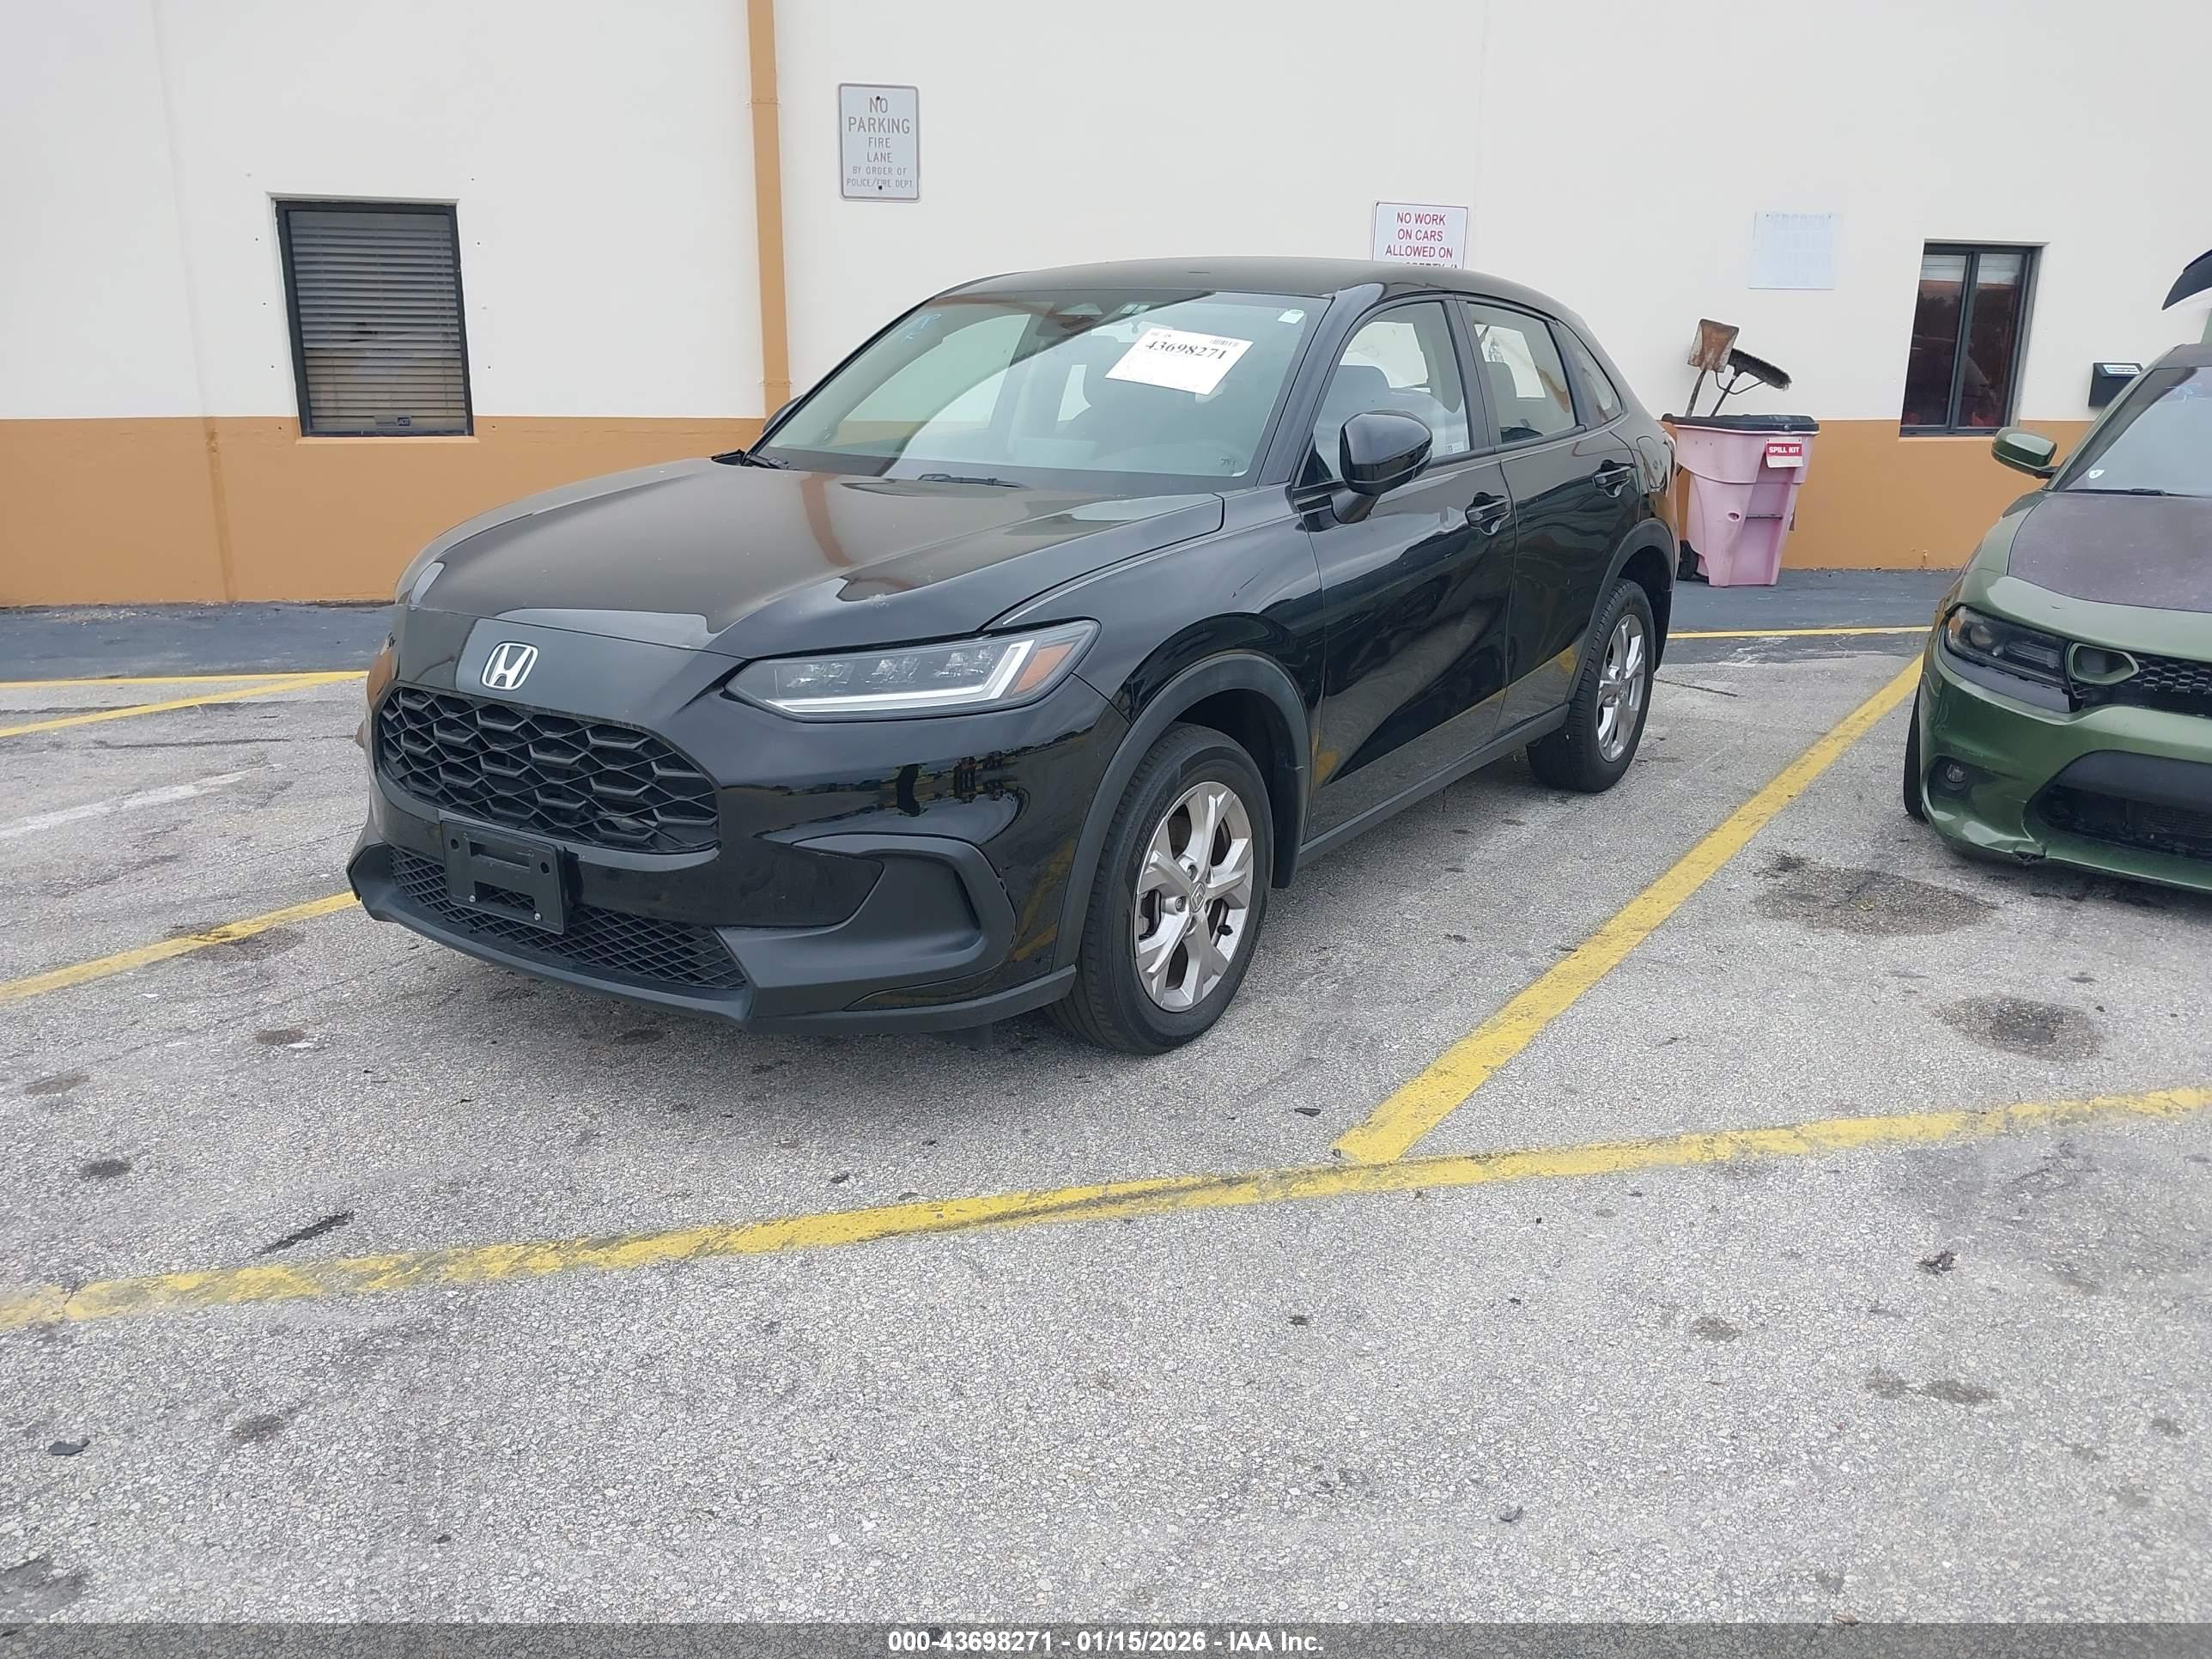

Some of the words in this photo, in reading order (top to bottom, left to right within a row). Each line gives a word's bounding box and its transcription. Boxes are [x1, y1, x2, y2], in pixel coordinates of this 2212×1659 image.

[869, 97, 888, 113] NO
[848, 117, 910, 134] PARKING
[868, 137, 890, 149] FIRE
[867, 152, 892, 163] LANE
[853, 166, 861, 174] BY
[866, 167, 893, 176] ORDER
[897, 167, 908, 176] OF
[1396, 212, 1412, 224] NO
[1414, 213, 1446, 226] WORK
[1397, 228, 1412, 240] ON
[1415, 229, 1443, 241] CARS
[1385, 244, 1436, 258] ALLOWED
[1438, 246, 1453, 258] ON
[1146, 340, 1228, 360] 43698271
